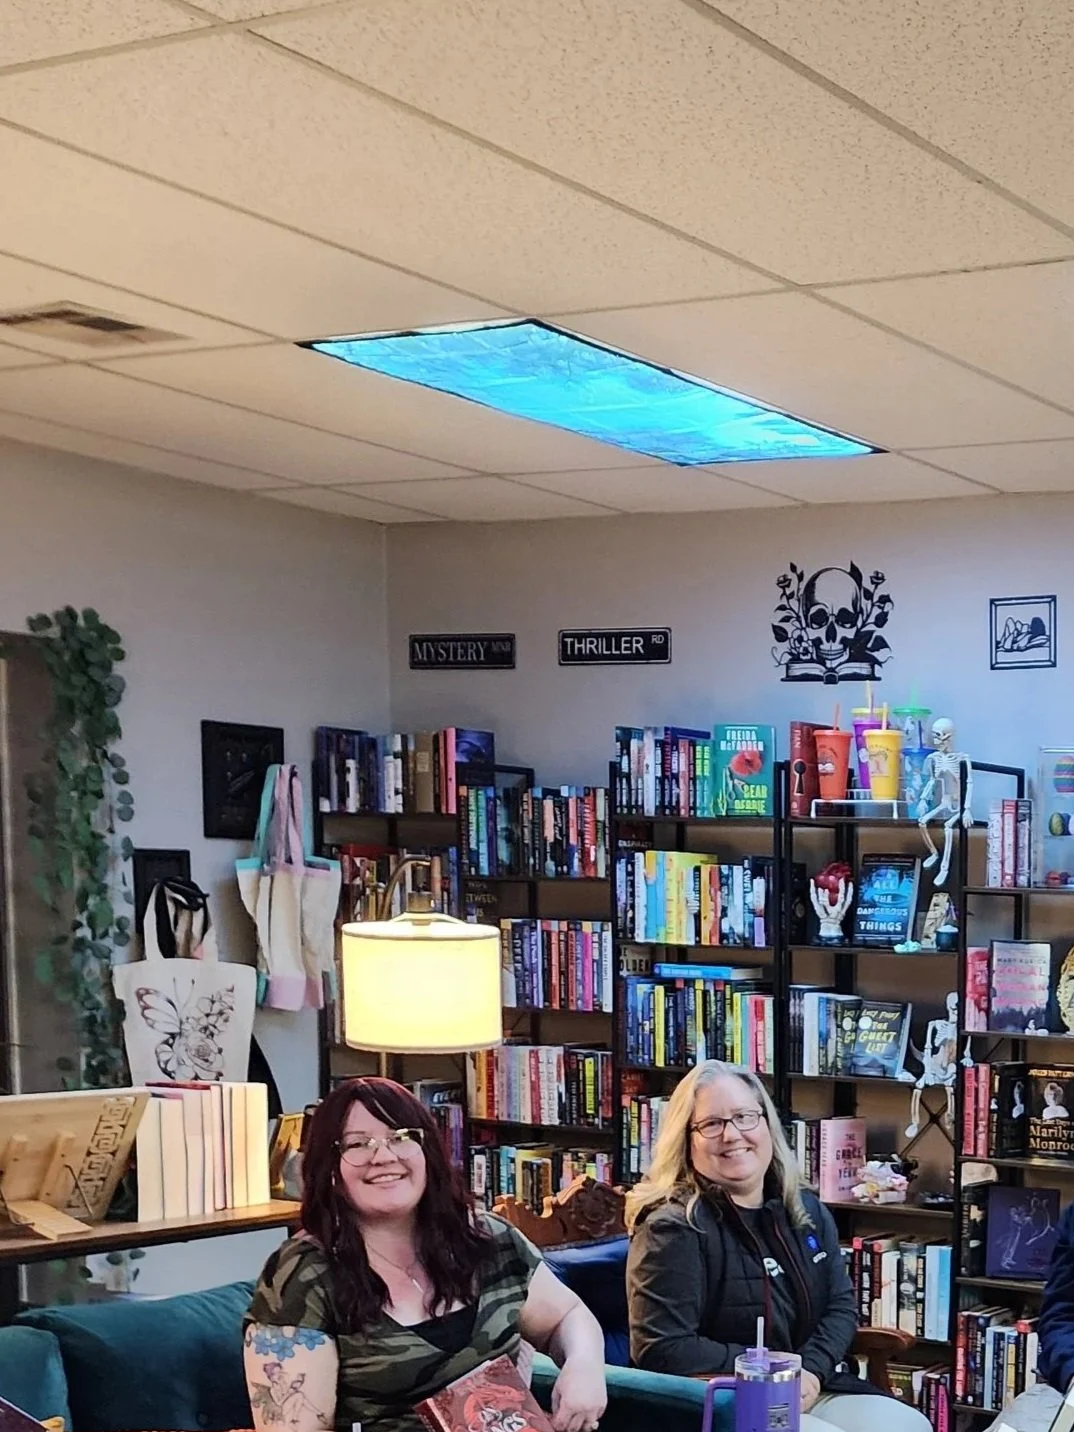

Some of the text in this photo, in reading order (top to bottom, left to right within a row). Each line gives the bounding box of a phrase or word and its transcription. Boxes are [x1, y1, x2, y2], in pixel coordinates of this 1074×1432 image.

[563, 634, 664, 657] THRILLER RD
[413, 641, 487, 662] MYSTERY
[726, 730, 757, 740] FREIDA
[873, 880, 896, 889] ALL
[874, 895, 893, 903] THE
[856, 907, 908, 917] DANGEROUS
[860, 921, 902, 931] THINGS
[872, 1022, 889, 1030] THE
[858, 1031, 897, 1042] GUEST
[865, 1043, 888, 1053] LIST
